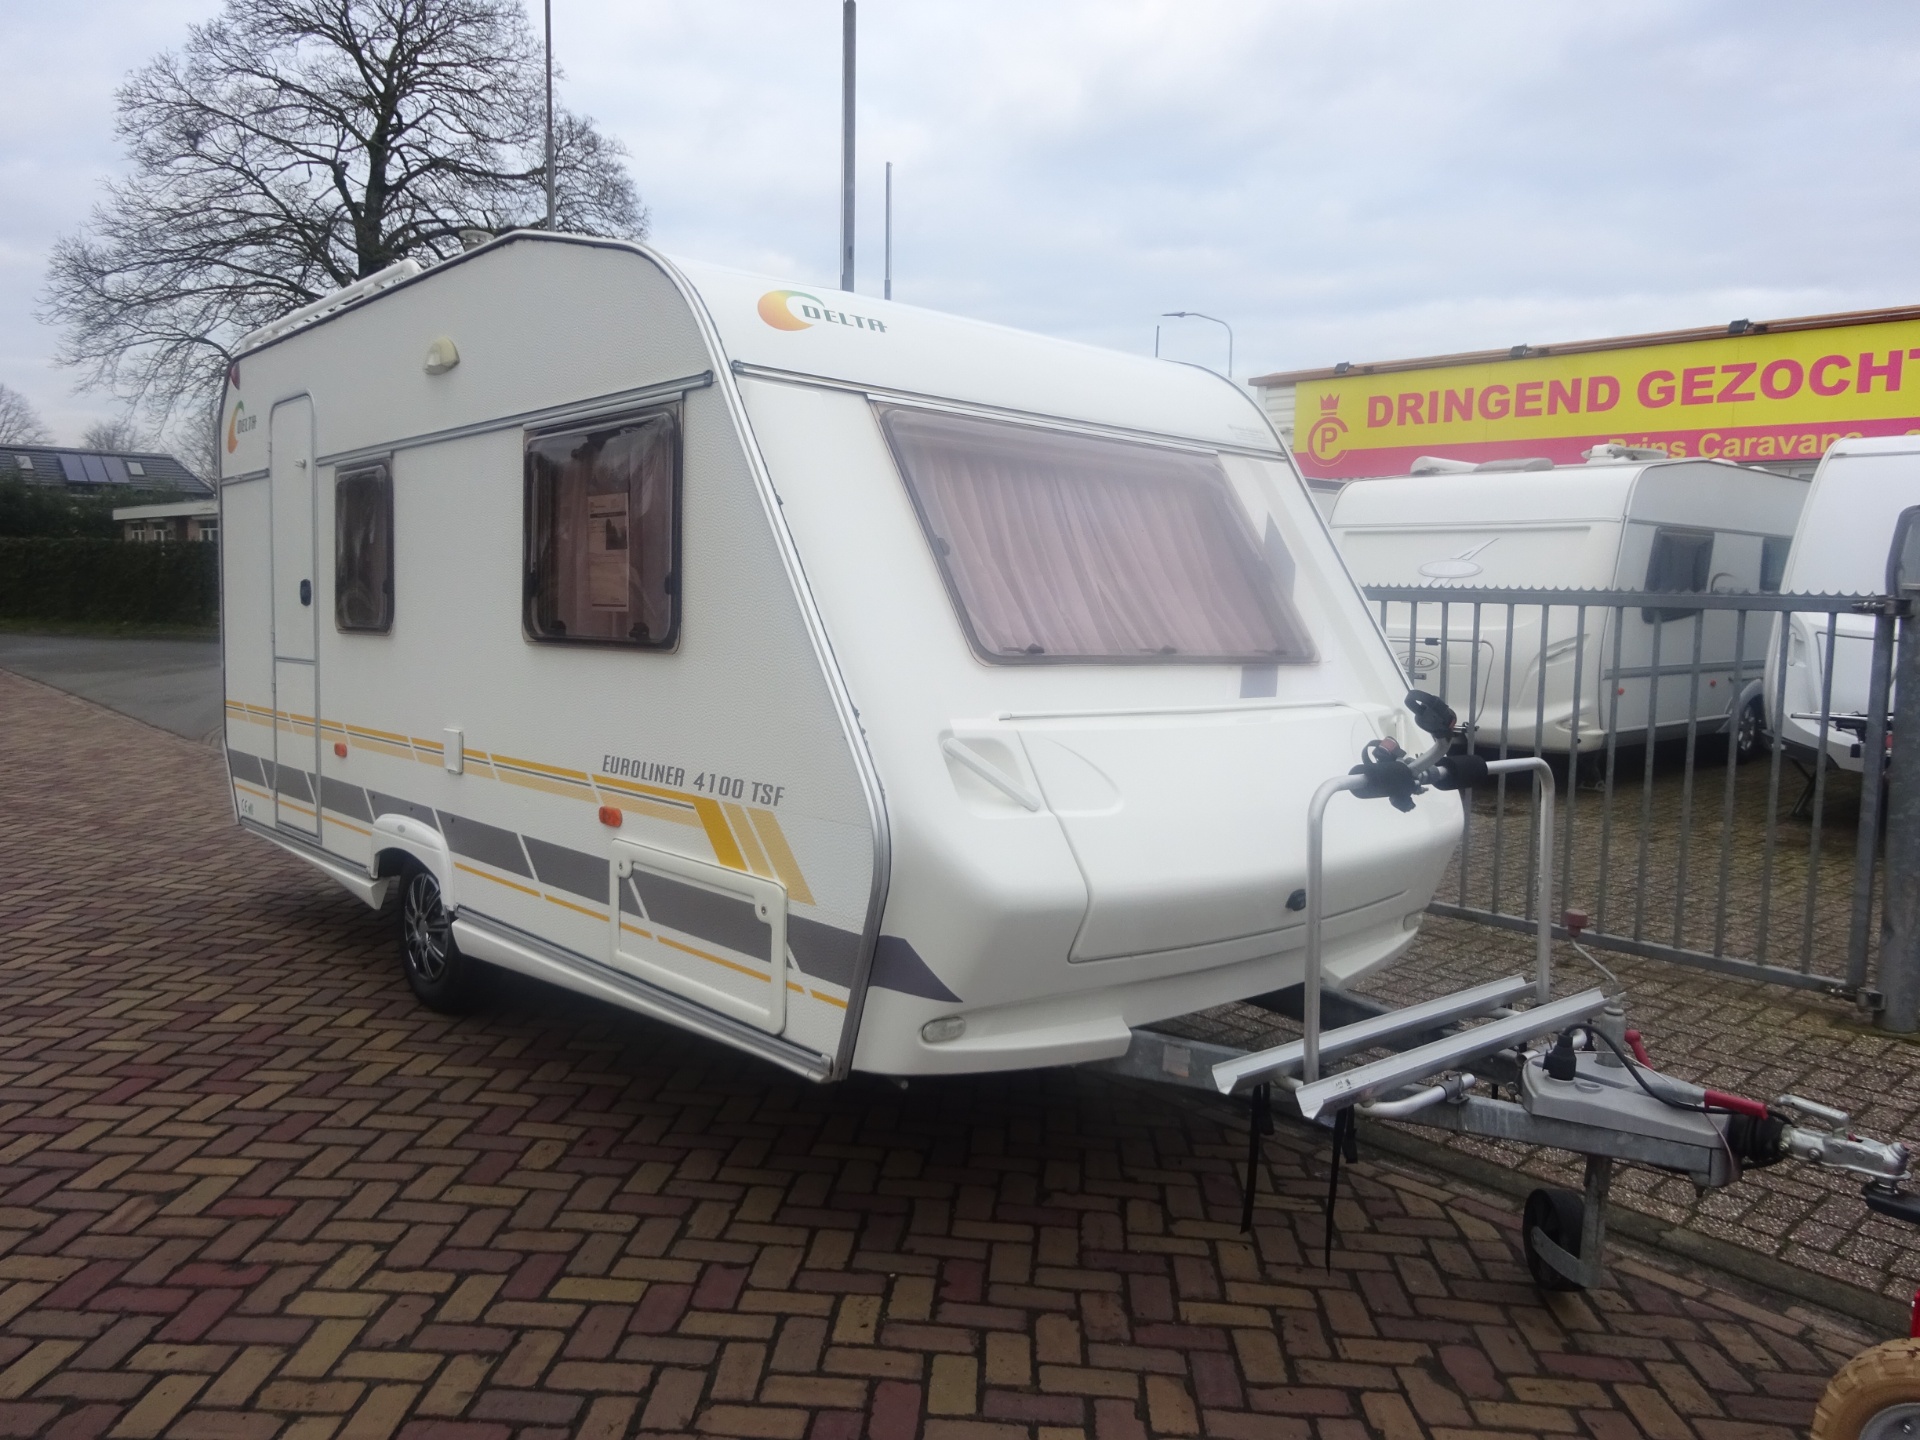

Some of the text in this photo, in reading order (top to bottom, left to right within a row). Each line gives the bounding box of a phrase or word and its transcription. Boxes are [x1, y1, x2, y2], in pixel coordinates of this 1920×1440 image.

[802, 305, 888, 333] DELTA
[1367, 348, 1920, 428] DRINGEND GEZOCH
[1698, 430, 1863, 458] Caravan
[602, 755, 785, 807] EUROLINER 4100 TSF
